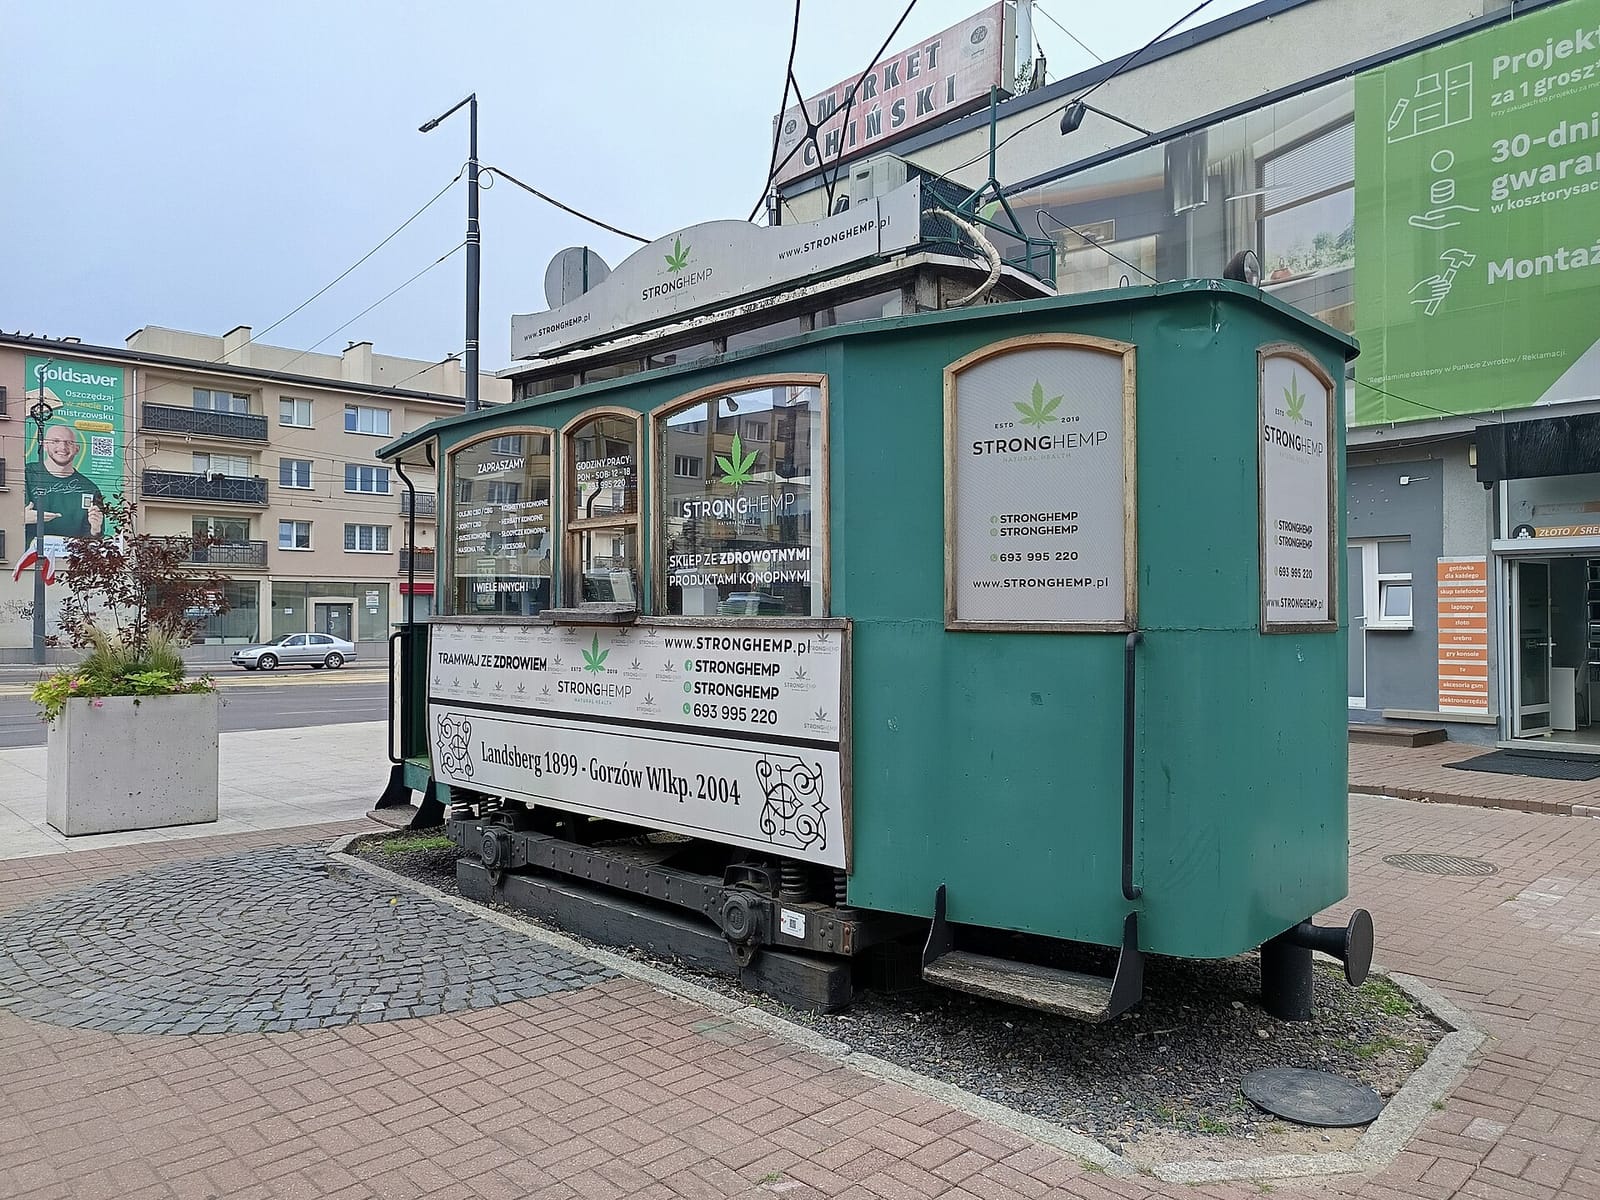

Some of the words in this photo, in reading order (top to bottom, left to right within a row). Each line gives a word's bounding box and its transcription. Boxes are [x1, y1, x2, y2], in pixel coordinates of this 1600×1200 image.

[816, 38, 942, 124] MARKET
[1491, 89, 1514, 107] za
[1519, 81, 1529, 97] 1
[802, 72, 957, 168] CHIŃSKI
[1491, 111, 1599, 163] 30-dni
[1491, 203, 1504, 214] w
[1507, 181, 1599, 210] kosztorysac
[777, 215, 892, 260] www.STRONGHEMP.pl
[641, 267, 713, 301] STRONGHEMP
[523, 313, 591, 342] www.STRONGHEMP.pl
[1452, 361, 1481, 371] Punkcie
[34, 364, 117, 387] Goldsaver
[65, 389, 114, 402] Oszczędzaj
[58, 408, 114, 420] mistrzowsku
[103, 404, 114, 412] po
[972, 430, 1108, 456] STRONGHEMP
[1264, 424, 1323, 457] STRONGHEMP
[477, 458, 525, 474] ZAPRASZAMY
[575, 459, 606, 471] GODZINY
[606, 455, 632, 467] PRACY:
[576, 472, 591, 481] PON
[595, 470, 611, 479] SOB:
[611, 468, 618, 477] 12
[623, 467, 631, 476] 18
[600, 480, 613, 489] 995
[613, 478, 626, 487] 220
[526, 498, 549, 508] KONOPNE
[683, 492, 795, 518] STRONGHEMP
[520, 513, 544, 523] KONOPNE
[1000, 512, 1078, 524] STRONGHEMP
[523, 526, 547, 535] KONOPNE
[1000, 525, 1078, 537] STRONGHEMP
[1278, 520, 1313, 535] STRONGHEMP
[1539, 528, 1570, 537] ZŁOTO
[1572, 526, 1579, 536] /
[1278, 535, 1313, 549] STRONGHEMP
[669, 554, 702, 568] SKLEP
[703, 553, 718, 566] ZE
[719, 547, 810, 565] ZDROWOTNYMI
[999, 553, 1022, 562] 693
[1027, 552, 1050, 562] 995
[1055, 551, 1079, 561] 220
[669, 574, 737, 587] PRODUKTAMI
[739, 569, 810, 584] KONOPNYMI
[1278, 566, 1289, 577] 693
[1290, 567, 1302, 578] 995
[1302, 568, 1313, 579] 220
[476, 582, 497, 592] WIELE
[972, 577, 1108, 589] www.STRONGHEMP.pl
[664, 637, 811, 656] www.STRONGHEMP.pl
[438, 652, 480, 667] TRAMWAJ
[480, 654, 493, 667] ZE
[493, 655, 547, 671] ZDROWIEM
[695, 659, 780, 677] STRONGHEMP
[557, 680, 632, 698] STRONGHEMP
[694, 681, 780, 700] STRONGHEMP
[693, 703, 718, 719] 693
[721, 705, 747, 722] 995
[750, 708, 778, 725] 220
[480, 741, 542, 778] Landsberg
[543, 751, 578, 777] 1899
[589, 758, 643, 788] Gorzów
[646, 765, 693, 803] Wlkp.
[696, 774, 741, 806] 2004
